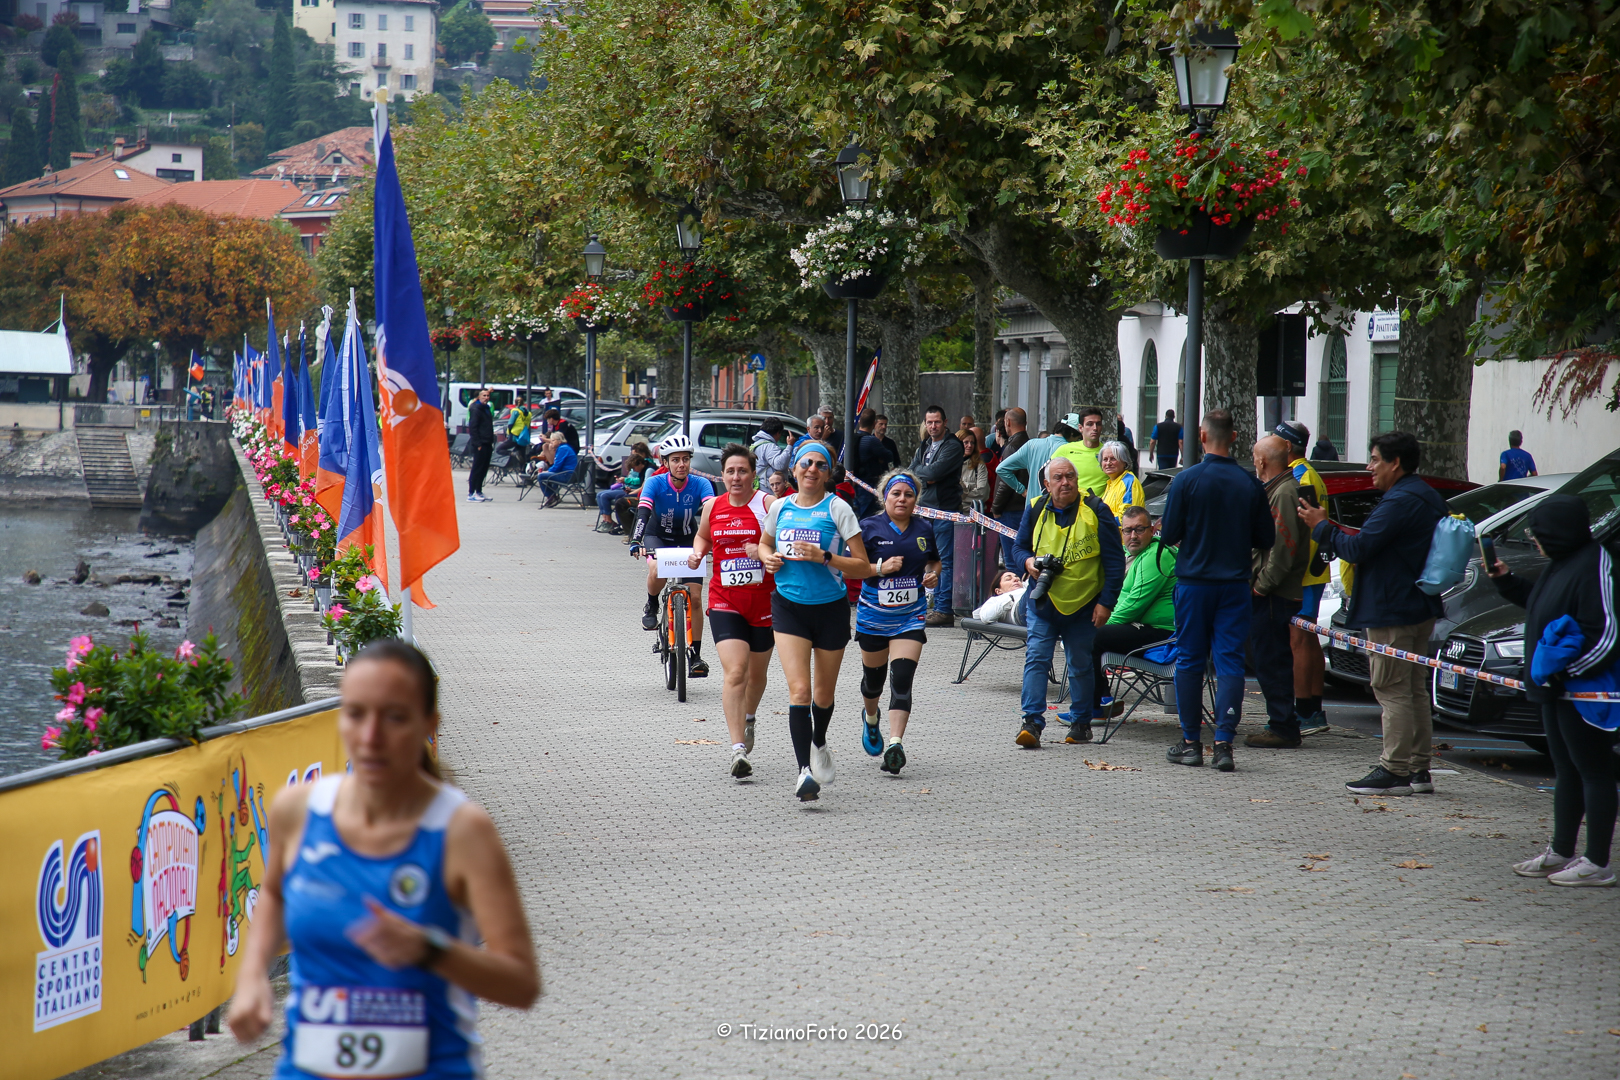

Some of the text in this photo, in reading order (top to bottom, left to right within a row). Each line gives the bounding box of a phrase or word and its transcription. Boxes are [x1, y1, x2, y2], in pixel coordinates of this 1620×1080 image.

[730, 572, 753, 585] 329
[887, 591, 909, 603] 264
[38, 947, 100, 980] CENTRO
[38, 966, 100, 999] SPORTIVO
[36, 983, 100, 1018] ITALIANO
[336, 1032, 384, 1070] 89
